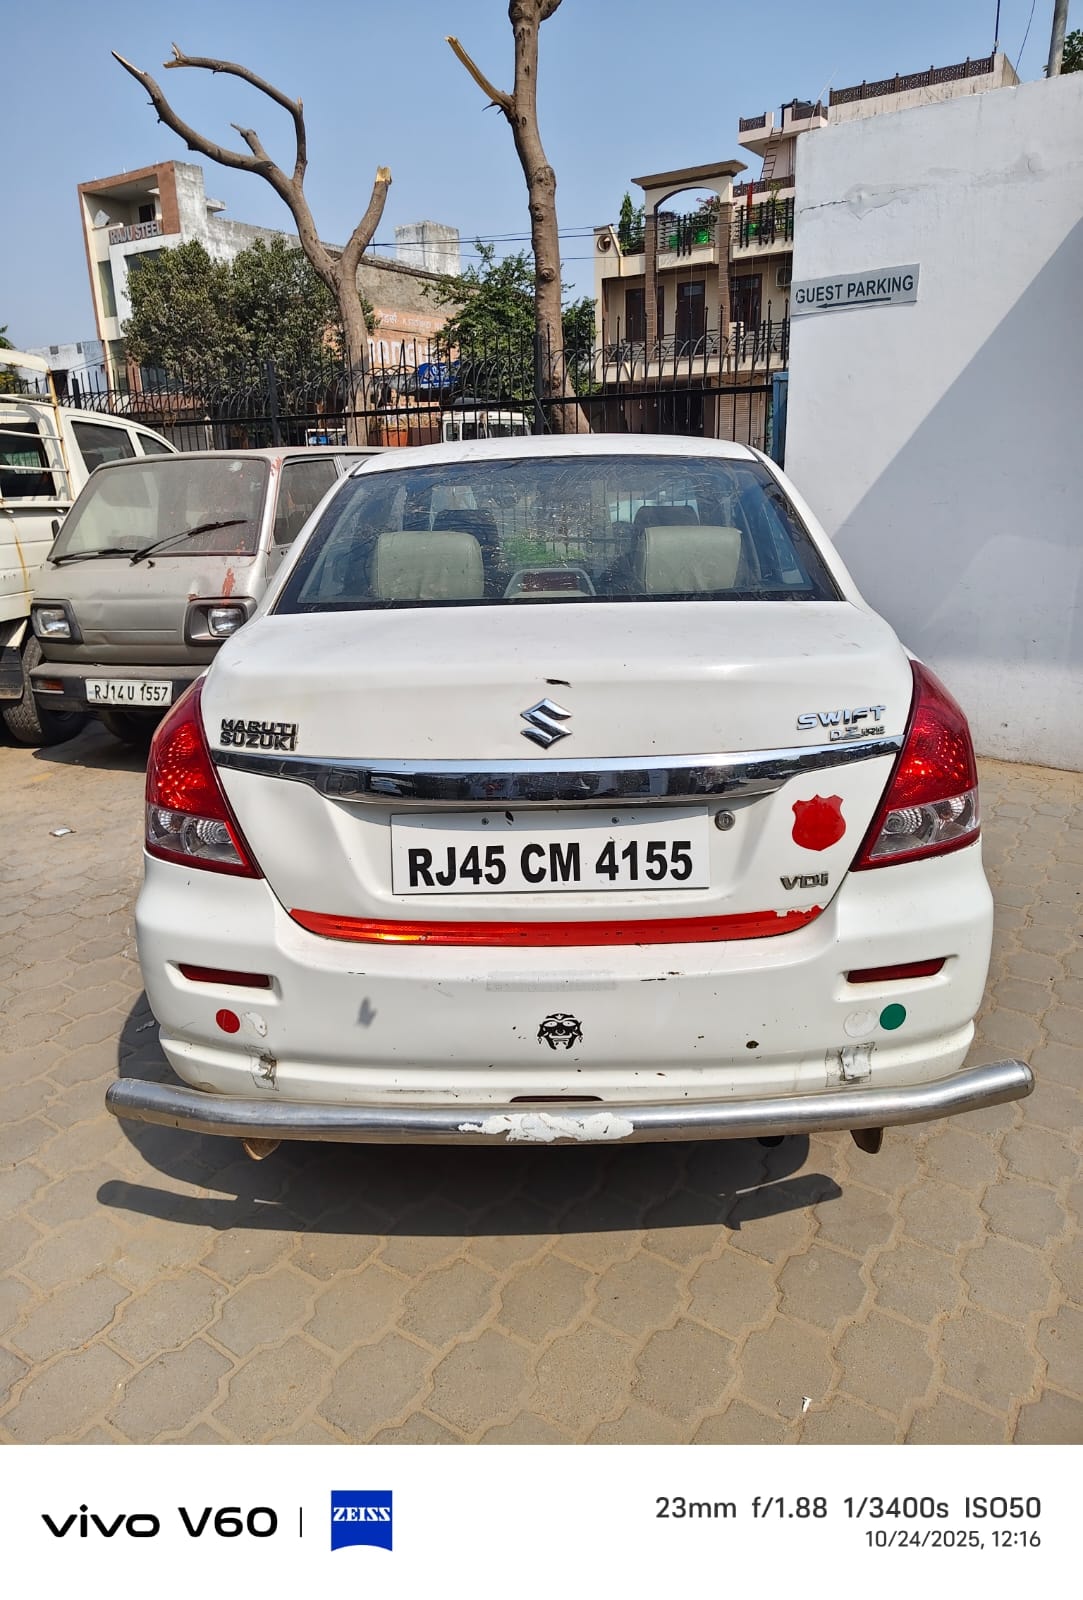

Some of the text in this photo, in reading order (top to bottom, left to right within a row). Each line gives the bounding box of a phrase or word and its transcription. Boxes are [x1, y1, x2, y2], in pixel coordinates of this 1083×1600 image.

[109, 225, 133, 244] RAJU
[795, 274, 914, 304] GUEST PARKING
[94, 683, 168, 702] RJ14 U 1557
[220, 718, 297, 736] MARUTI
[796, 704, 887, 731] SWIFT
[219, 731, 297, 752] SUZUKI
[407, 840, 693, 887] RJ45 CM 4155
[779, 872, 829, 891] VDi
